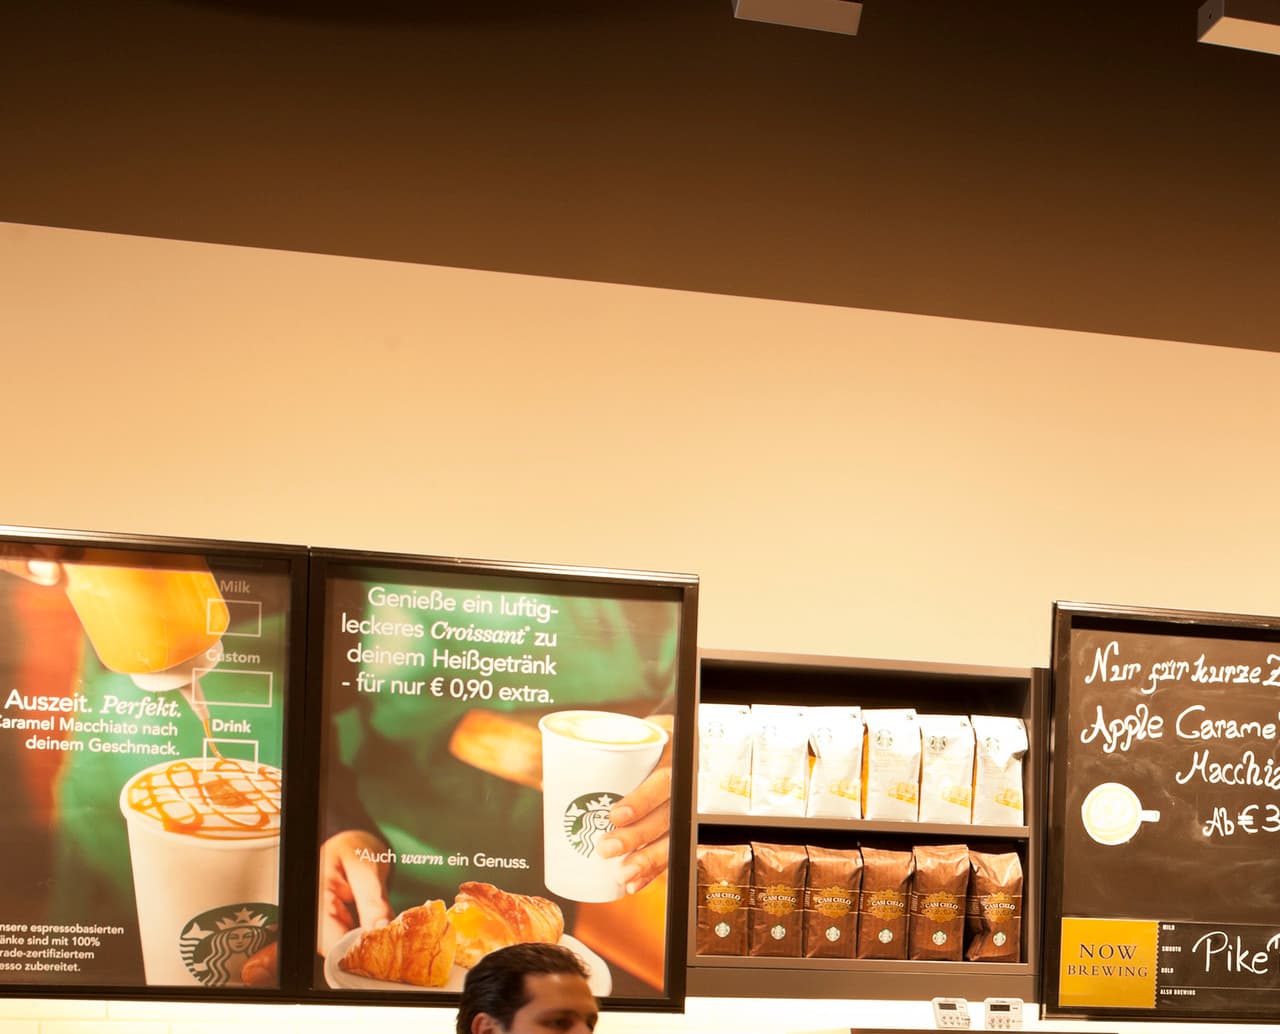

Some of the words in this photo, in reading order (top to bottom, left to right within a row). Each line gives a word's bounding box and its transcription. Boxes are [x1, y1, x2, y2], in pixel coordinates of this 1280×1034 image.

[220, 580, 250, 593] Milk
[368, 586, 456, 611] Genieße
[463, 596, 493, 614] ein
[500, 595, 559, 624] luftig-
[341, 612, 424, 638] leckeres
[534, 632, 558, 647] zu
[206, 650, 261, 664] Custom
[346, 643, 425, 666] deinem
[432, 648, 558, 676] Heißgetränk
[1084, 641, 1142, 684] Nur
[1190, 652, 1263, 684] kurze
[356, 672, 384, 692] für
[390, 680, 426, 696] nur
[430, 677, 444, 697] €
[450, 678, 494, 702] 0,90
[498, 684, 554, 704] extra.
[4, 688, 92, 713] Auszeit.
[99, 695, 182, 719] Perfekt.
[59, 717, 138, 734] Macchiato
[142, 722, 178, 736] nach
[212, 718, 252, 733] Drink
[1080, 703, 1164, 753] Apple
[25, 734, 84, 751] deinem
[88, 738, 180, 756] Geschmack.
[1202, 806, 1235, 838] Ab
[400, 853, 444, 865] warm
[447, 852, 469, 866] ein
[473, 852, 530, 869] Genuss.
[30, 923, 124, 935] espressobasierten
[27, 936, 48, 946] sind
[52, 936, 68, 946] mit
[72, 936, 100, 946] 100%
[1080, 943, 1138, 960] NOW
[1192, 931, 1270, 974] Pike
[24, 961, 81, 972] zubereitet.
[1068, 964, 1148, 978] BREWING
